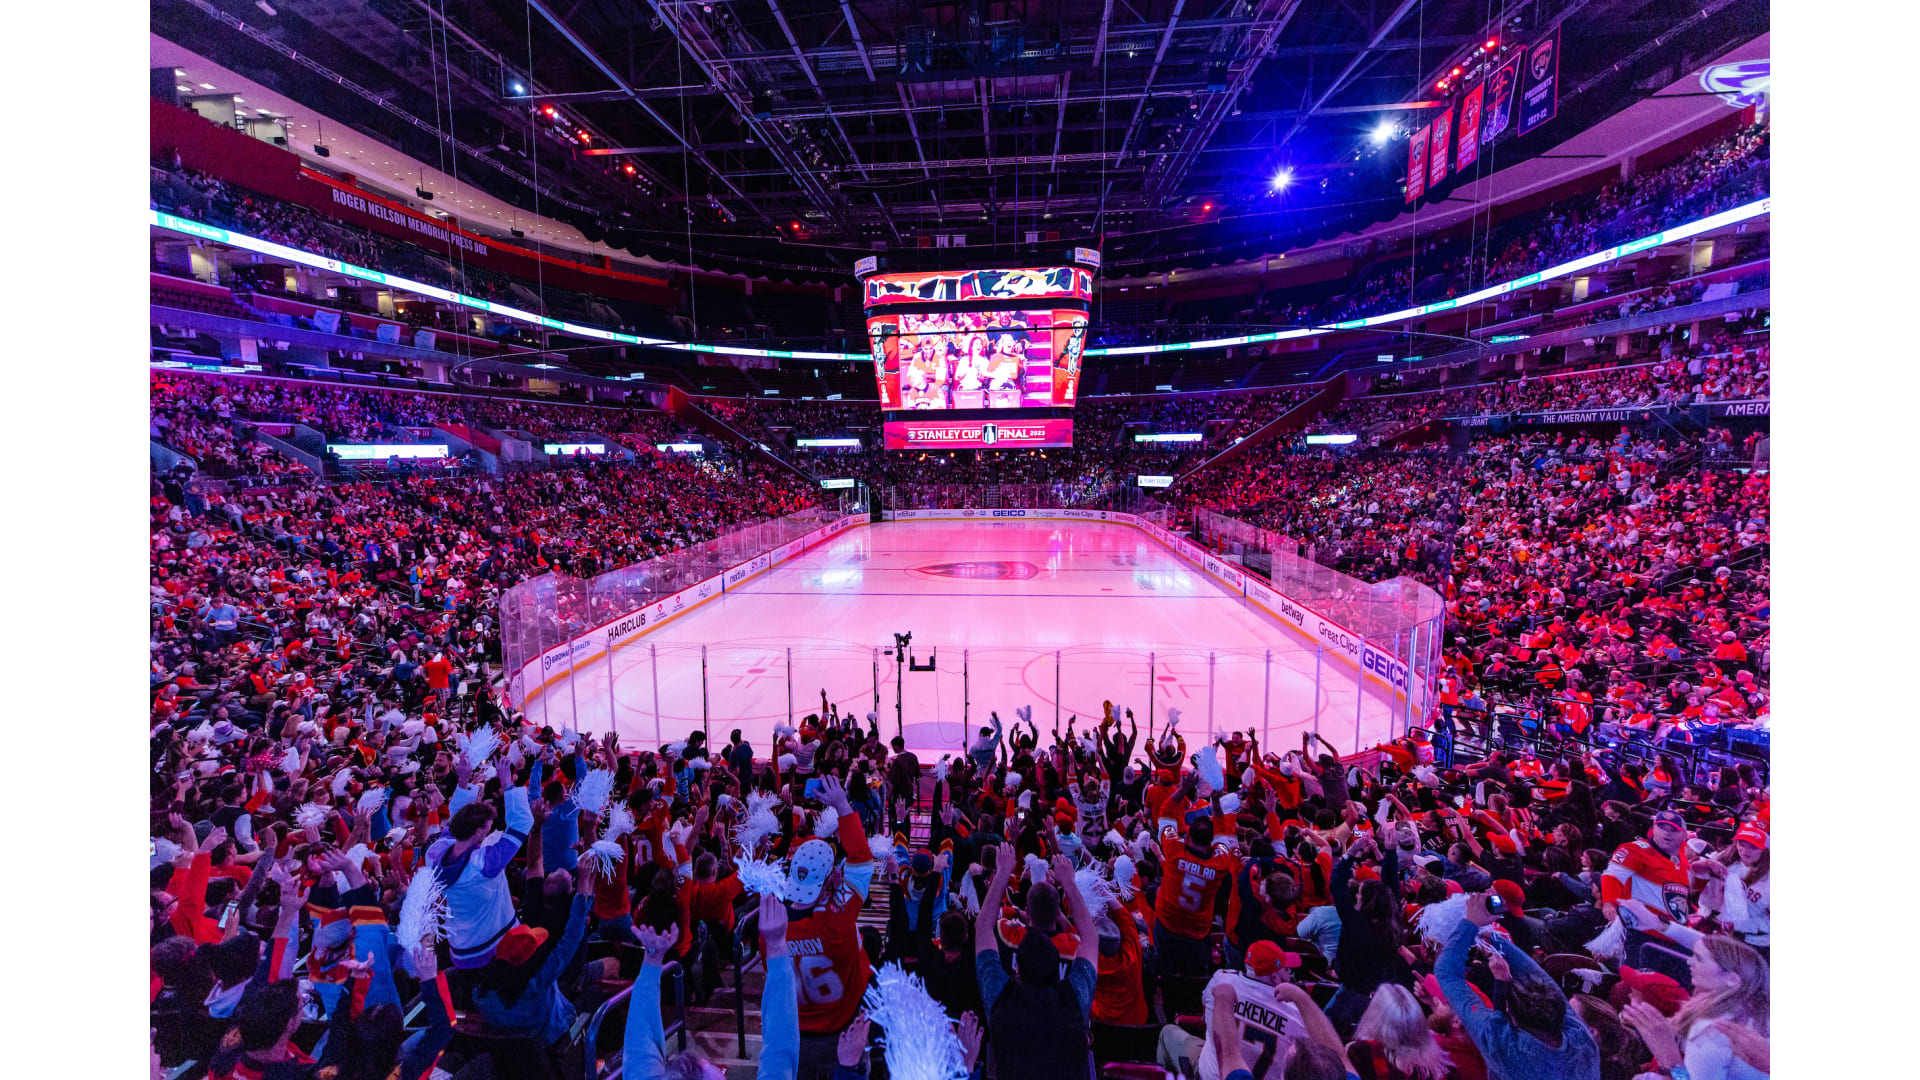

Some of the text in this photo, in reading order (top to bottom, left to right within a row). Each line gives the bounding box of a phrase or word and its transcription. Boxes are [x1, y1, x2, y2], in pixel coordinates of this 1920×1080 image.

[332, 188, 488, 256] ROGER NEILSON MEMORIAL PRESS BOX
[1543, 414, 1556, 424] THE
[1557, 412, 1597, 423] AMERANT
[1600, 410, 1631, 421] VAULT
[917, 430, 959, 439] STANLEY
[962, 430, 981, 439] CUP
[998, 430, 1028, 439] FINAL
[1081, 510, 1093, 518] Clips
[730, 569, 746, 584] nextiva
[1281, 599, 1305, 626] betway
[608, 613, 646, 642] HAIRCLUB
[1319, 622, 1358, 656] Great Clips
[1178, 859, 1216, 880] EKBLAD
[1178, 873, 1207, 912] 5
